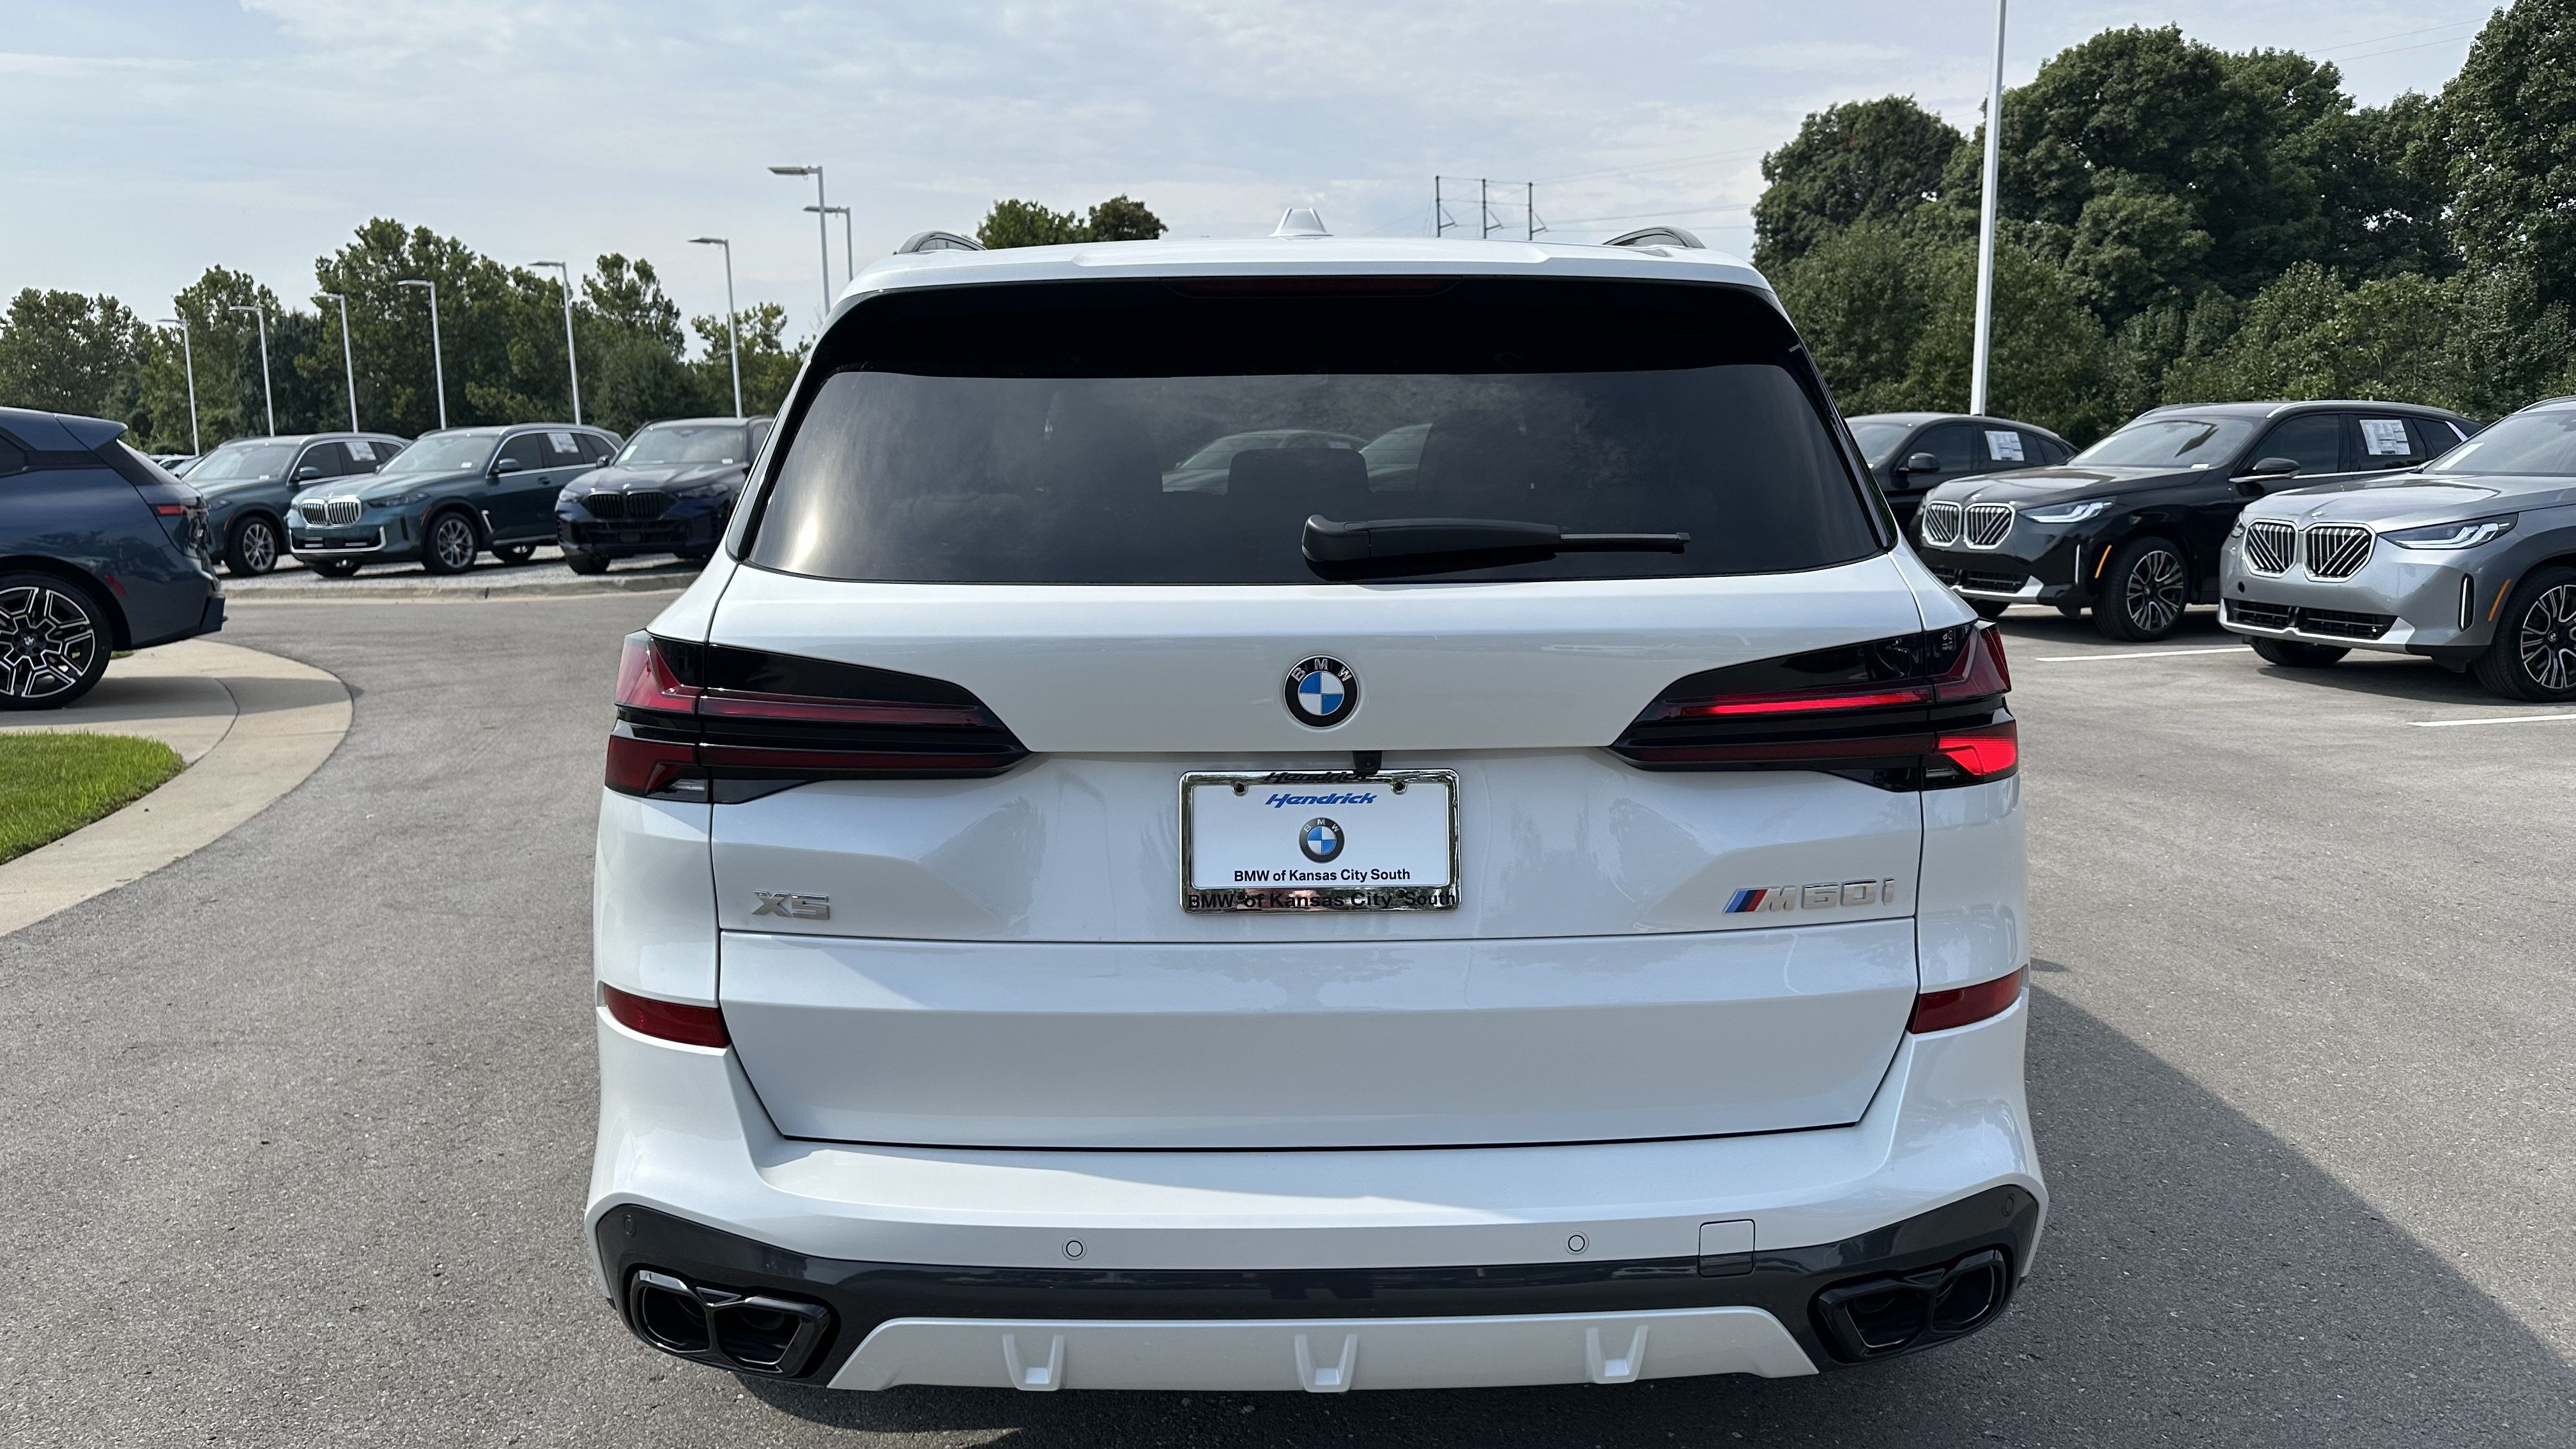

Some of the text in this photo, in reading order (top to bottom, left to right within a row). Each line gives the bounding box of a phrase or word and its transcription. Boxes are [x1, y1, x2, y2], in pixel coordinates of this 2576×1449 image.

[1291, 658, 1353, 682] BMW
[1265, 792, 1377, 808] Hendrick
[1303, 818, 1340, 832] BMW
[1234, 868, 1411, 883] BMW of Kansas City South
[752, 889, 830, 921] X5
[1188, 891, 1456, 908] BMW of Kansas City South
